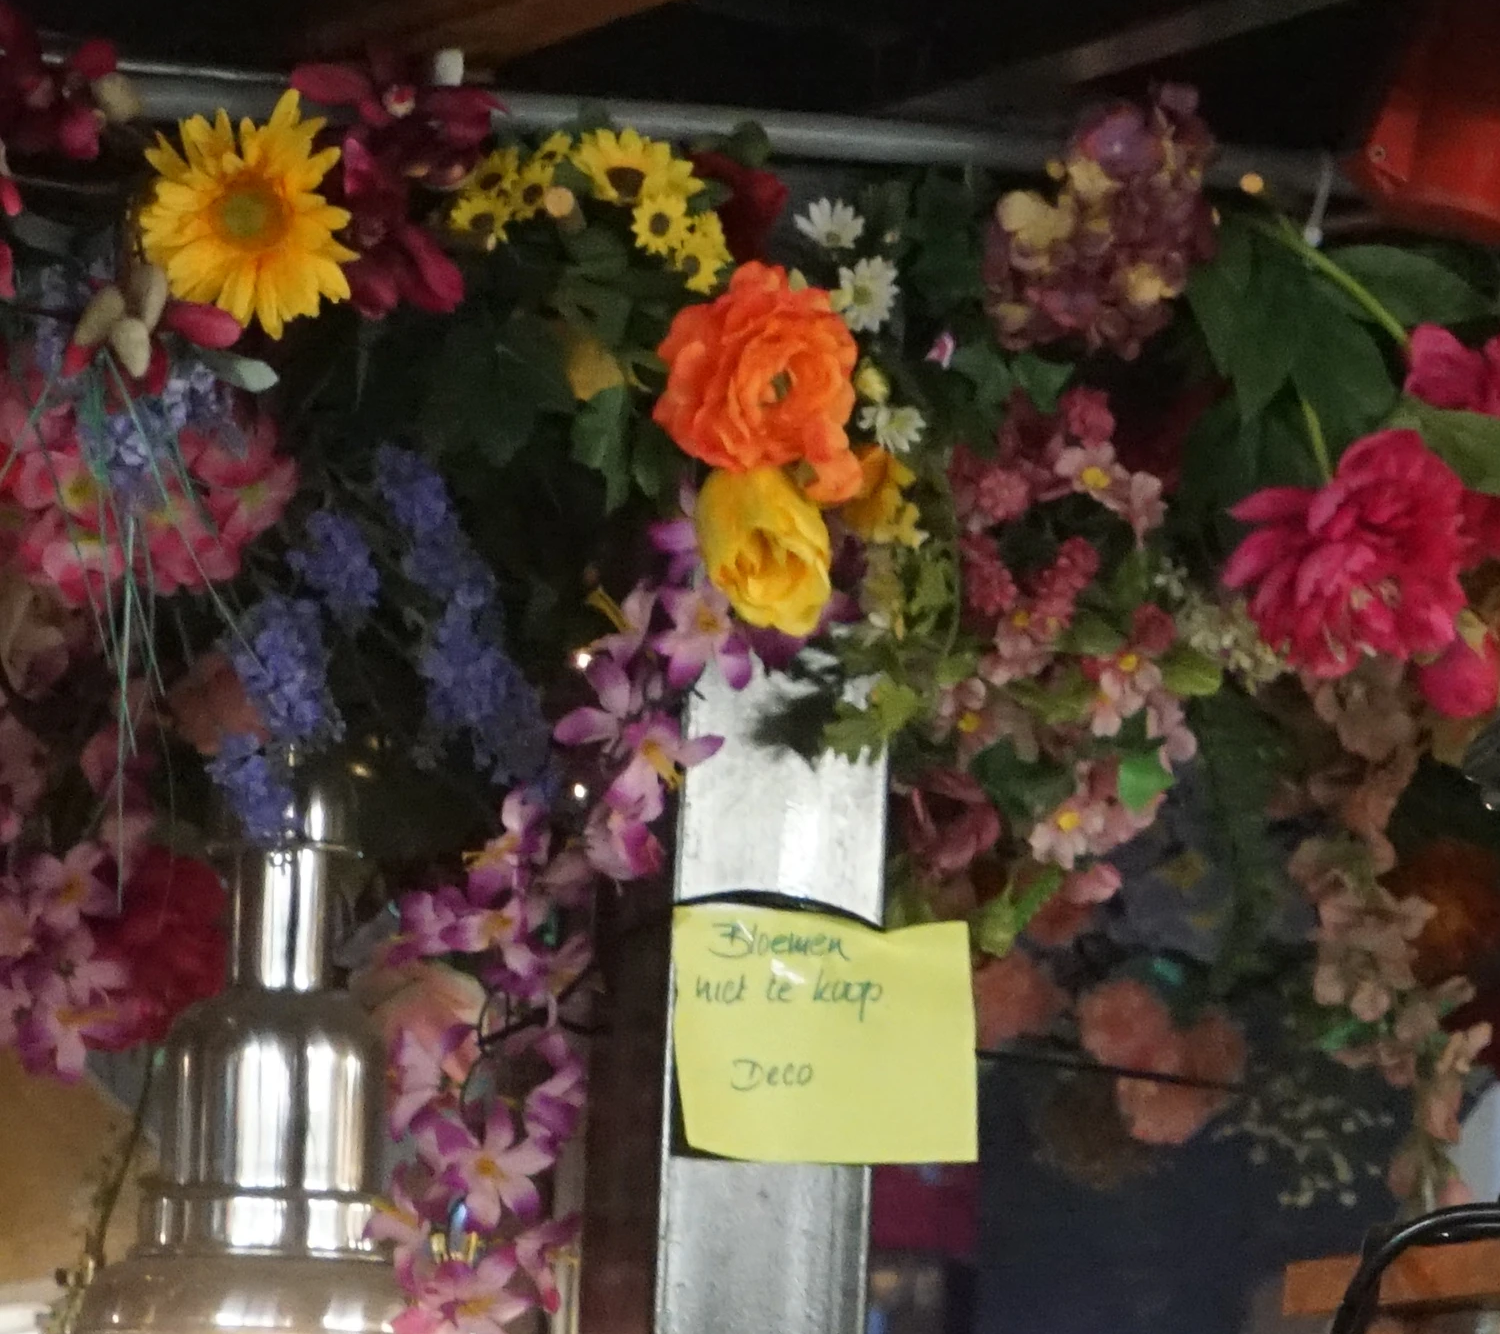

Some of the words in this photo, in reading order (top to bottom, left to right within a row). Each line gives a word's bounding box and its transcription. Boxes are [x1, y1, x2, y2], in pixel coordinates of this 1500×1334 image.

[709, 920, 850, 960] Bloemen
[696, 975, 745, 1003] niet
[731, 1059, 813, 1091] Deco
